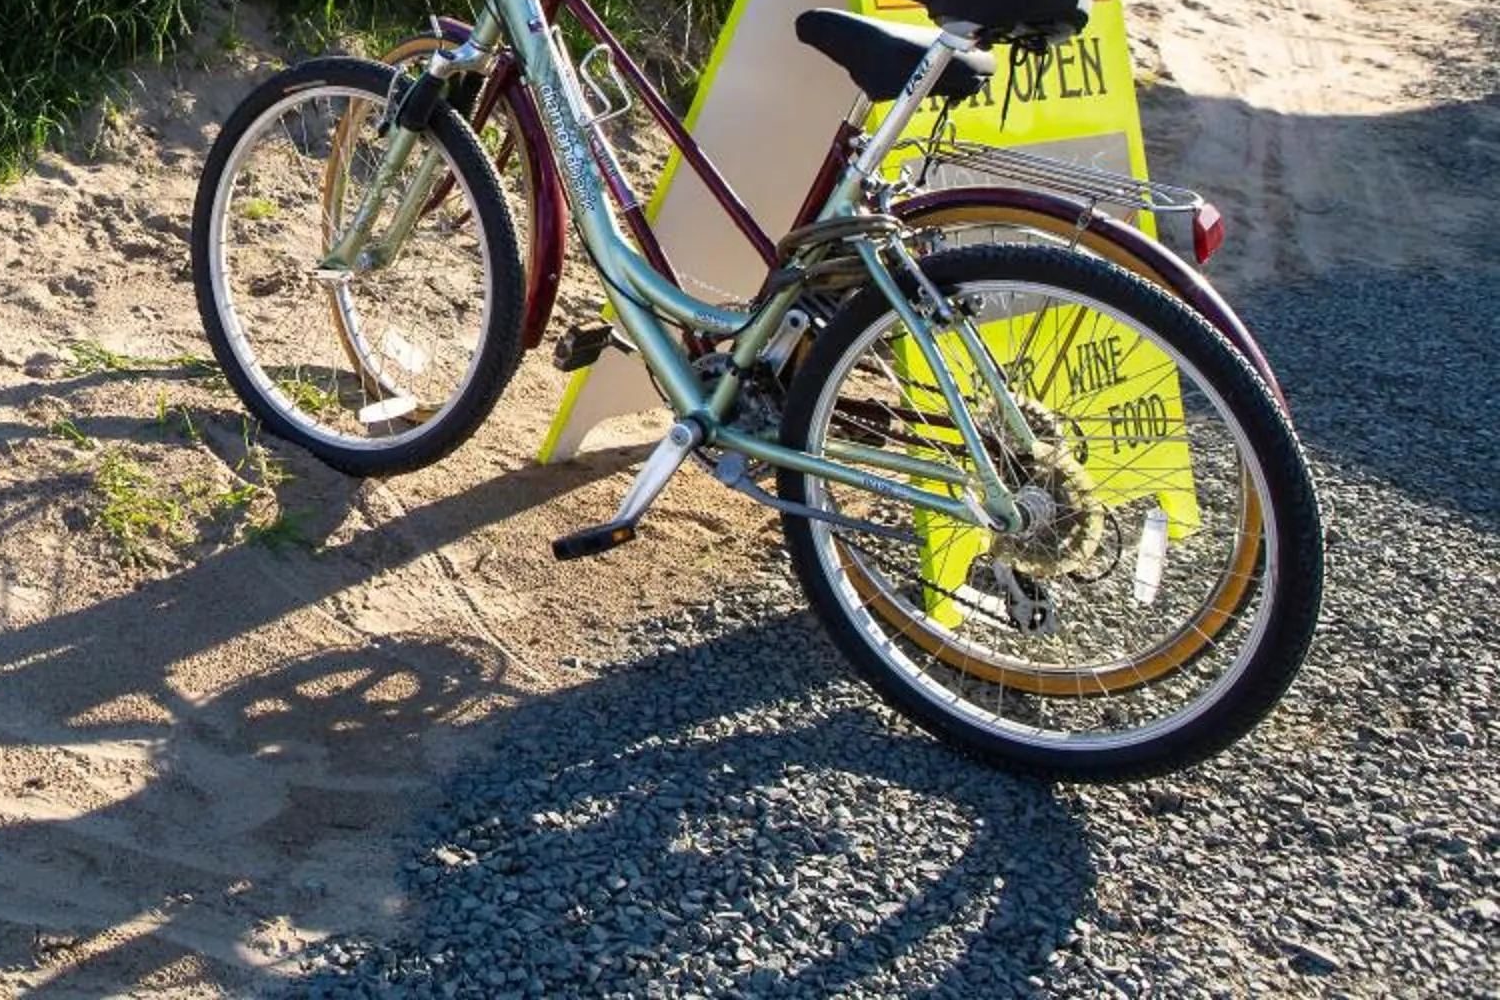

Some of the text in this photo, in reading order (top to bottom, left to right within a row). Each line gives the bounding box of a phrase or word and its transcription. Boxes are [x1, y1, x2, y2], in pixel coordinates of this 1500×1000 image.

[1011, 36, 1108, 103] OPEN
[1063, 335, 1127, 395] WINE
[1107, 392, 1168, 455] FOOD
